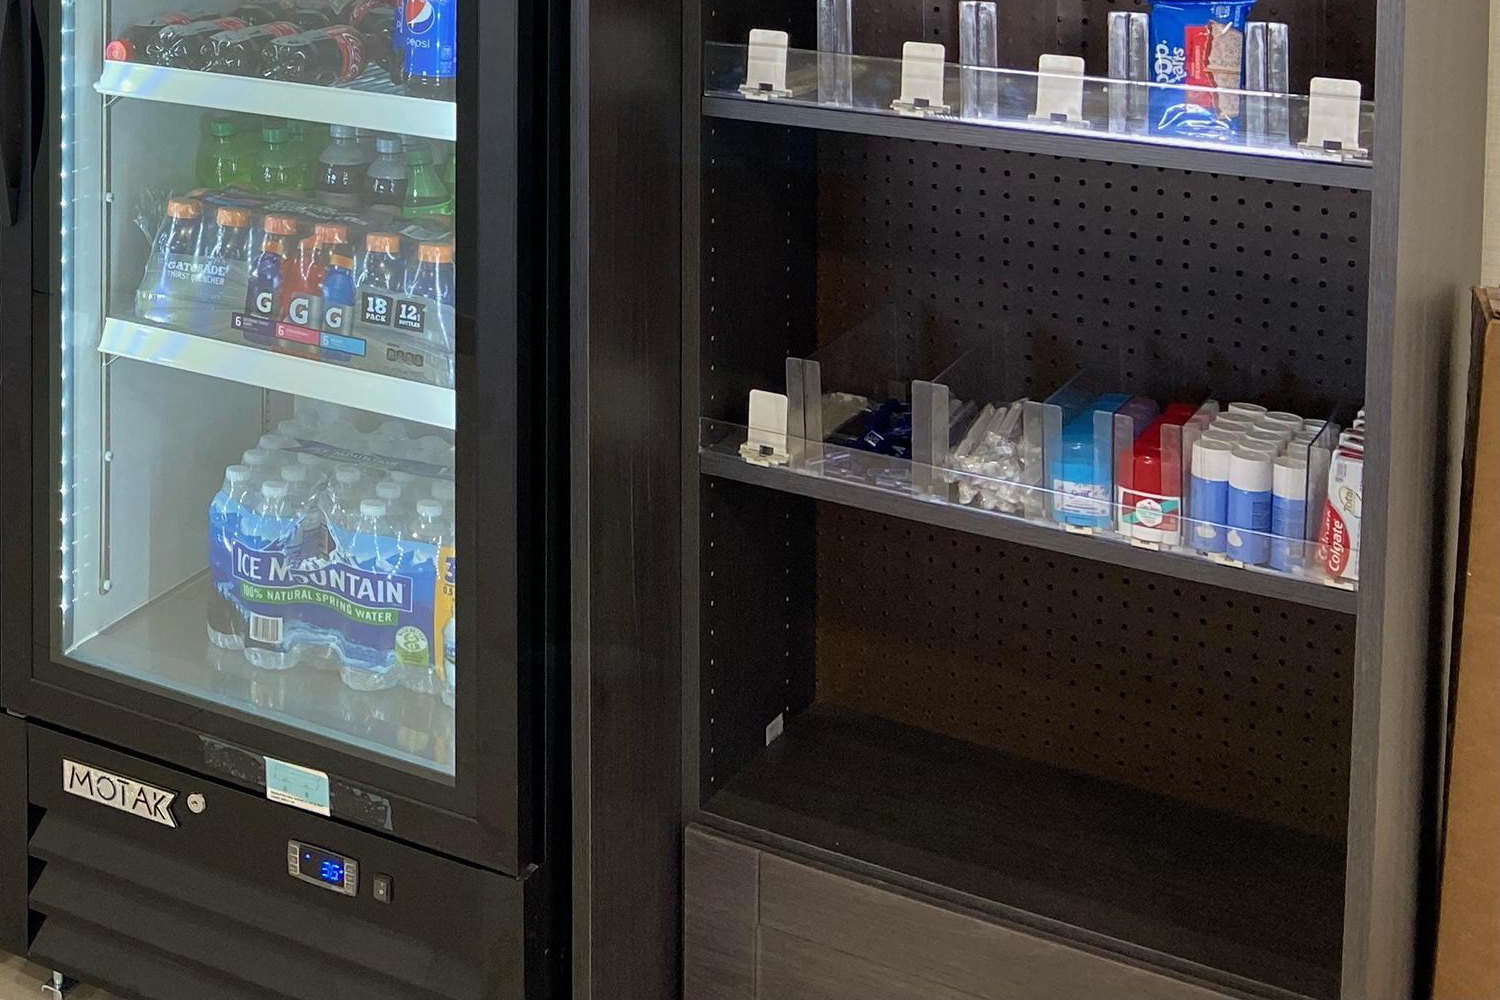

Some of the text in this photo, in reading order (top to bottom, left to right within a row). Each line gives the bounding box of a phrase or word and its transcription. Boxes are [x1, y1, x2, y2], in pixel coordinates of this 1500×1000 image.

[406, 37, 431, 49] pepsi
[167, 260, 226, 276] GATORADE
[167, 270, 224, 285] THIRST QUENCHER
[256, 292, 273, 313] G
[289, 298, 309, 324] G
[367, 296, 387, 315] 18
[325, 307, 342, 328] G
[365, 312, 386, 323] PACK
[399, 303, 417, 321] 12
[235, 316, 242, 327] 6
[278, 325, 285, 336] 6
[399, 319, 420, 328] BOTTLES
[322, 335, 329, 346] 6
[1328, 519, 1344, 572] Colgate
[237, 552, 404, 605] ICE MOUNTAIN
[242, 584, 392, 623] 100% NATURAL SPRING WATER
[70, 765, 166, 821] MOTAK
[321, 860, 339, 881] 36
